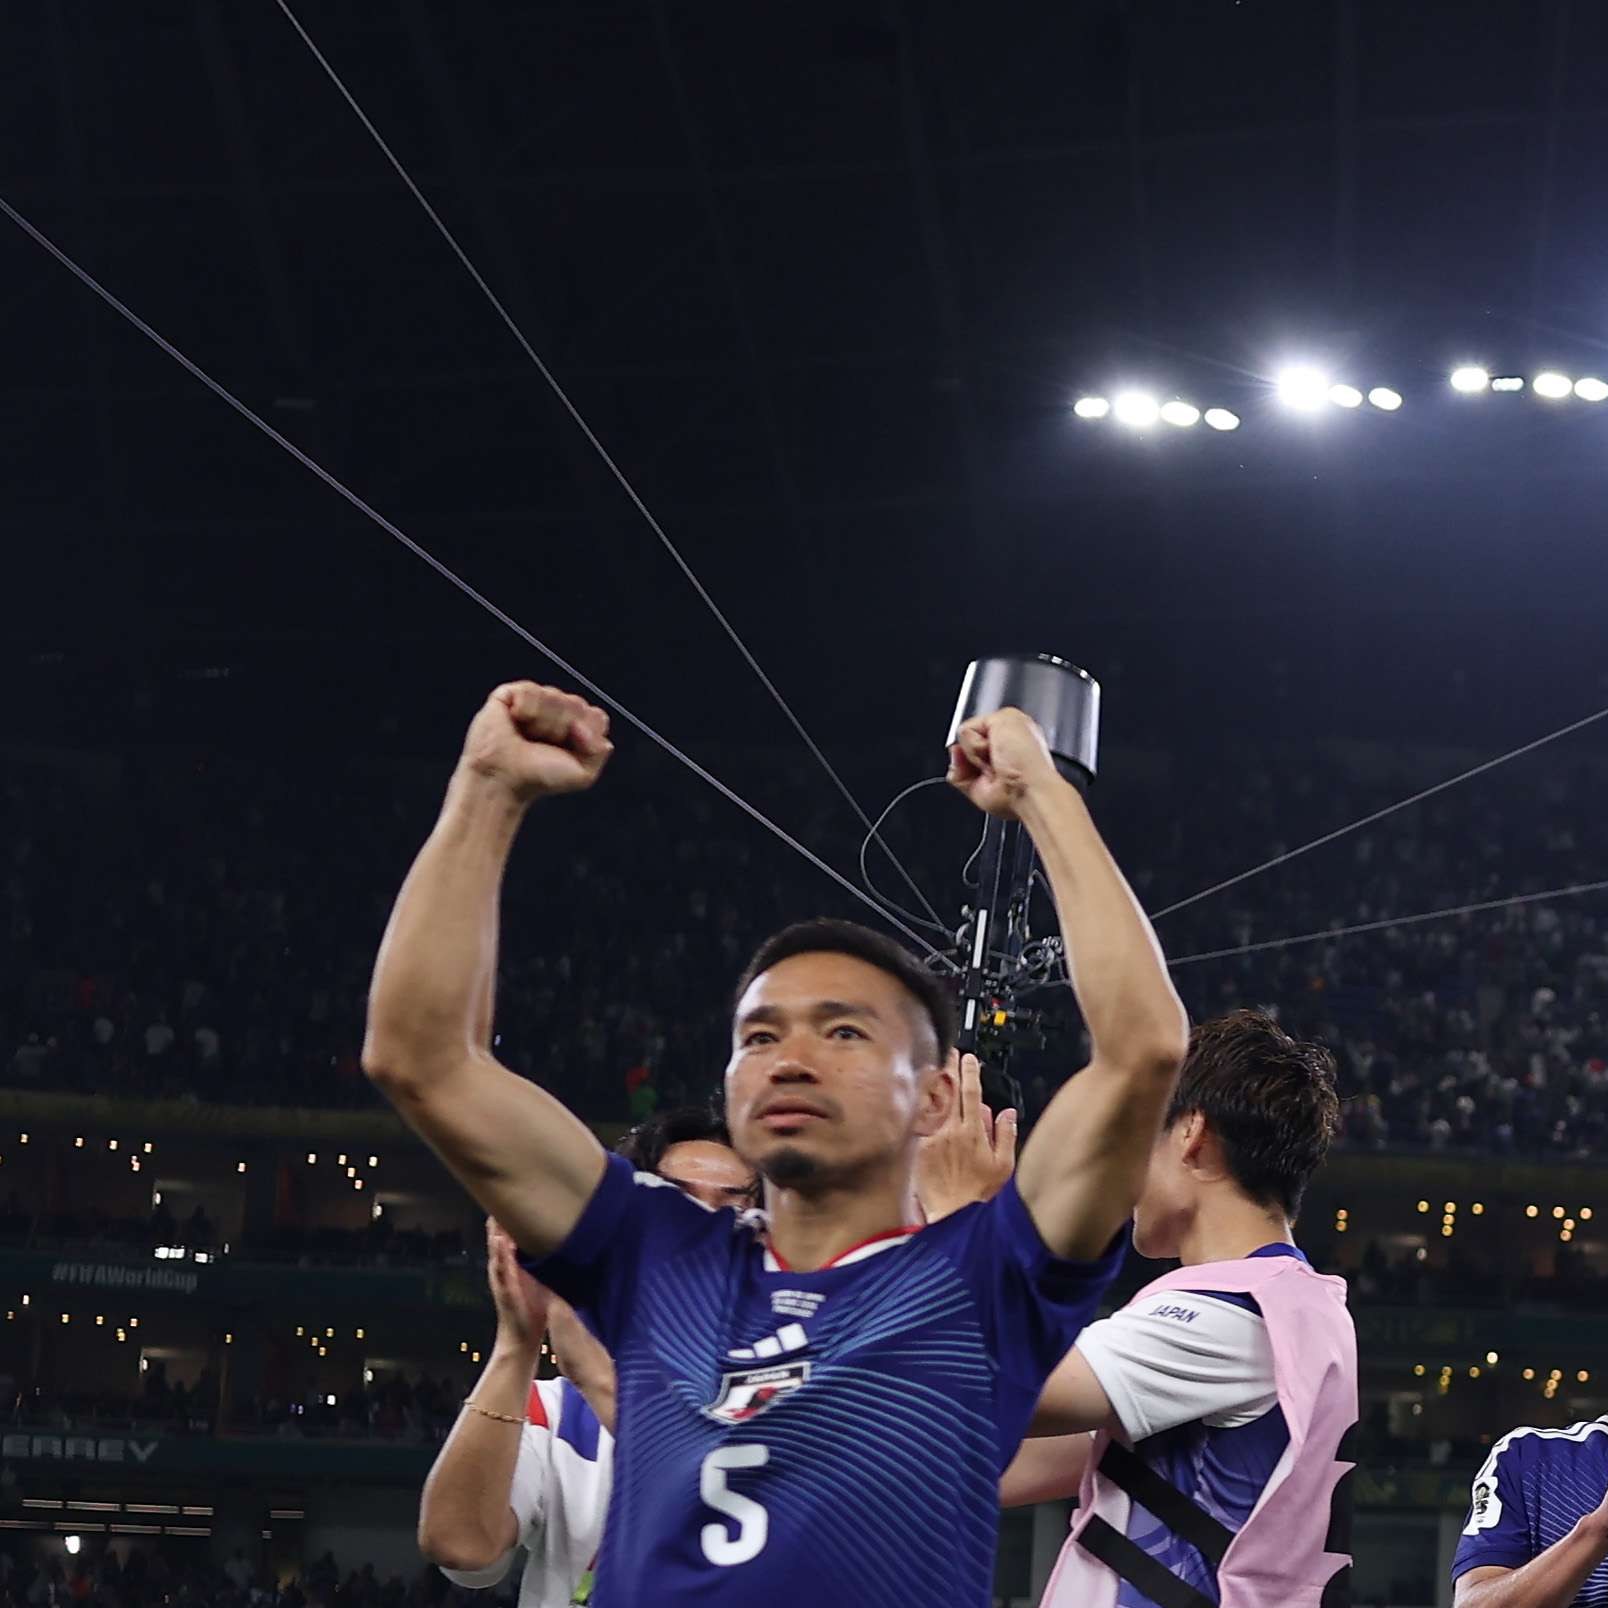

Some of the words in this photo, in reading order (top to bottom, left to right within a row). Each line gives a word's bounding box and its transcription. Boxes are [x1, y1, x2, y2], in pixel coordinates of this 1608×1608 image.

[53, 1265, 198, 1293] #FIFAWorldCup
[1149, 1305, 1200, 1323] JAPAN
[701, 1444, 769, 1566] 5
